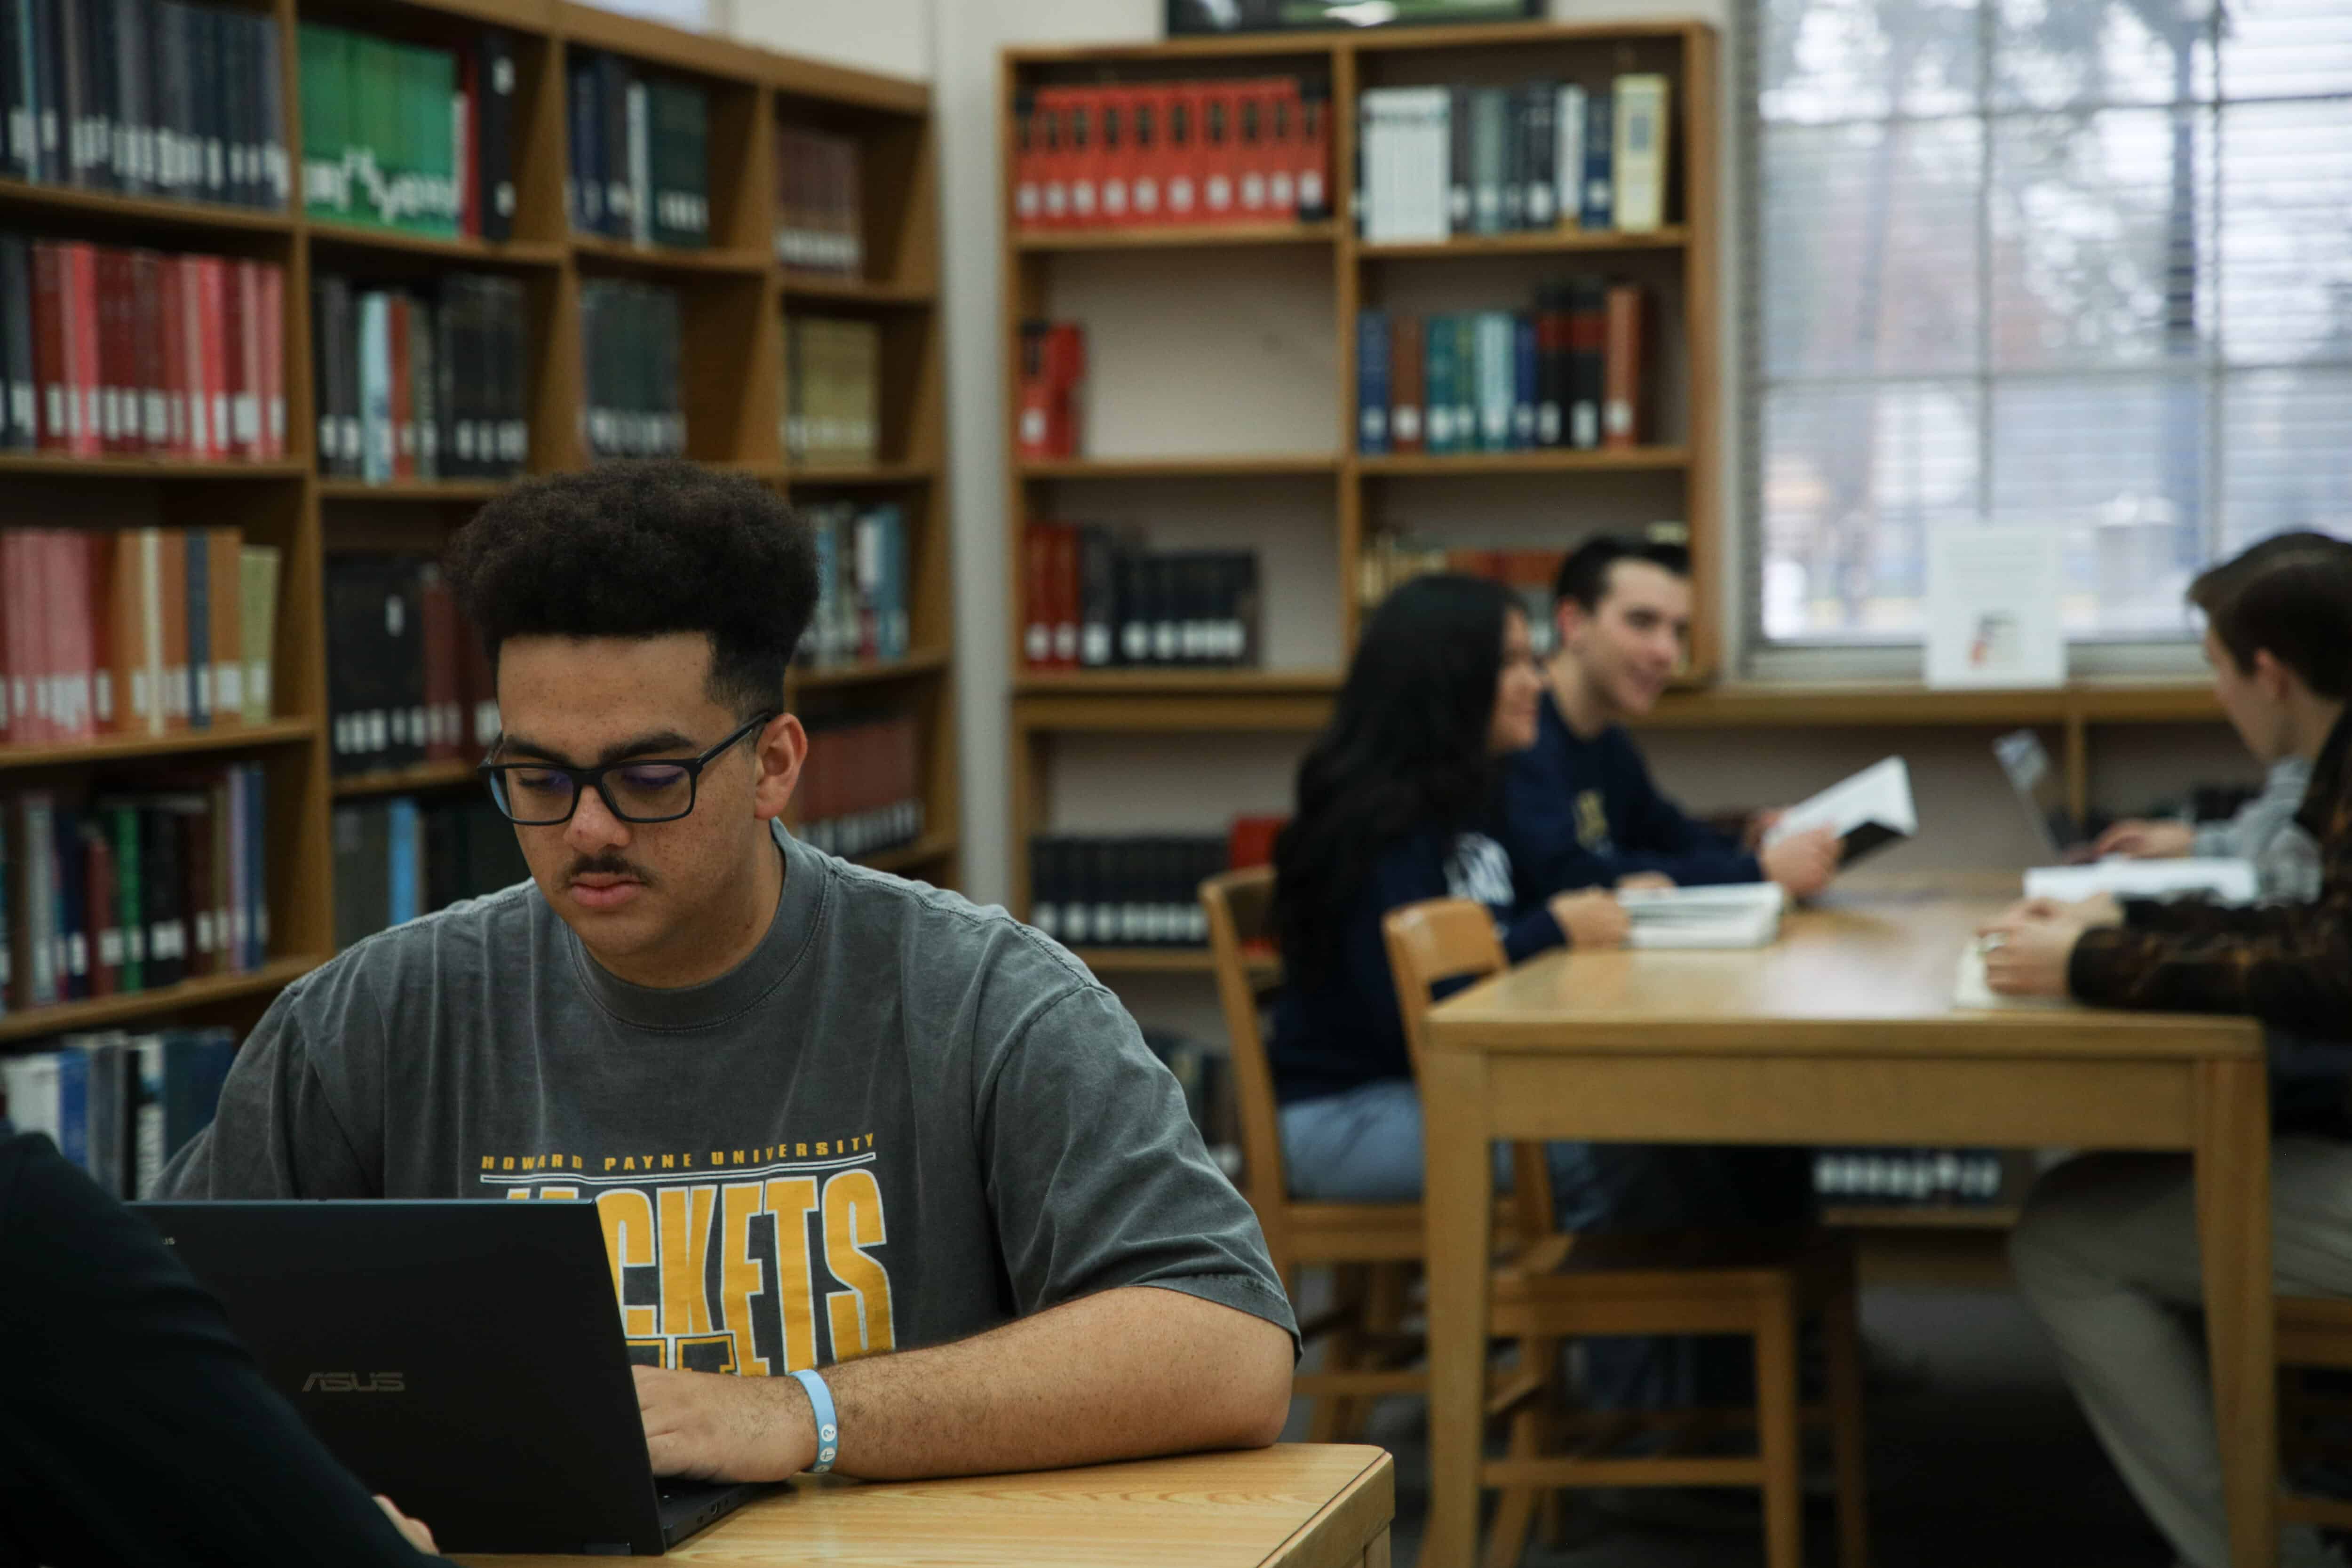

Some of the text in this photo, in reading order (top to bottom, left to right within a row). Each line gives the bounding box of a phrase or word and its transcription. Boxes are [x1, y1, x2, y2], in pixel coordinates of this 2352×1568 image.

[481, 1133, 874, 1171] HOWARD PAYNE UNIVERSITY
[507, 1169, 895, 1377] CKETS
[302, 1371, 406, 1393] ASUS
